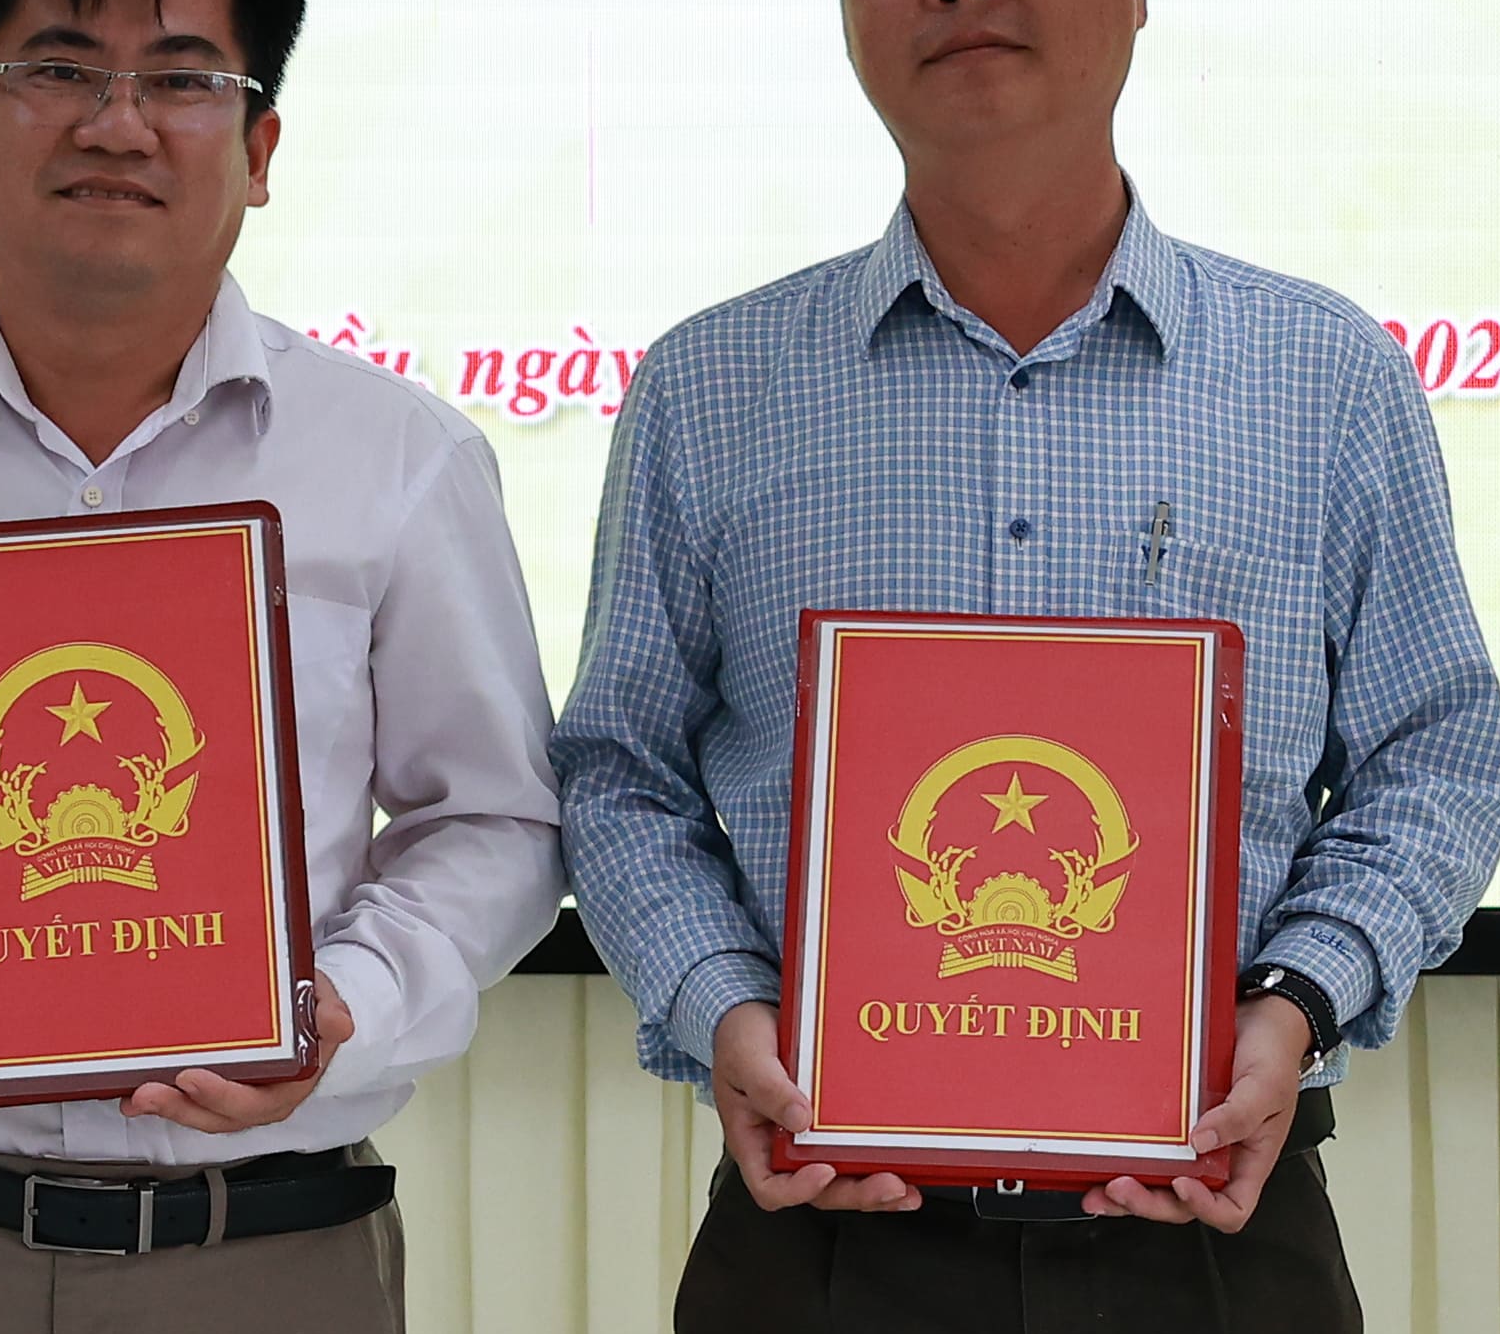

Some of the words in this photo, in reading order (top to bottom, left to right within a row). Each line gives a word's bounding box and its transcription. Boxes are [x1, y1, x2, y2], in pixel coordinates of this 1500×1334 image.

[113, 911, 225, 964] ĐỊNH
[858, 992, 1015, 1042] QUYẾT
[1027, 1005, 1141, 1049] ĐỊNH
